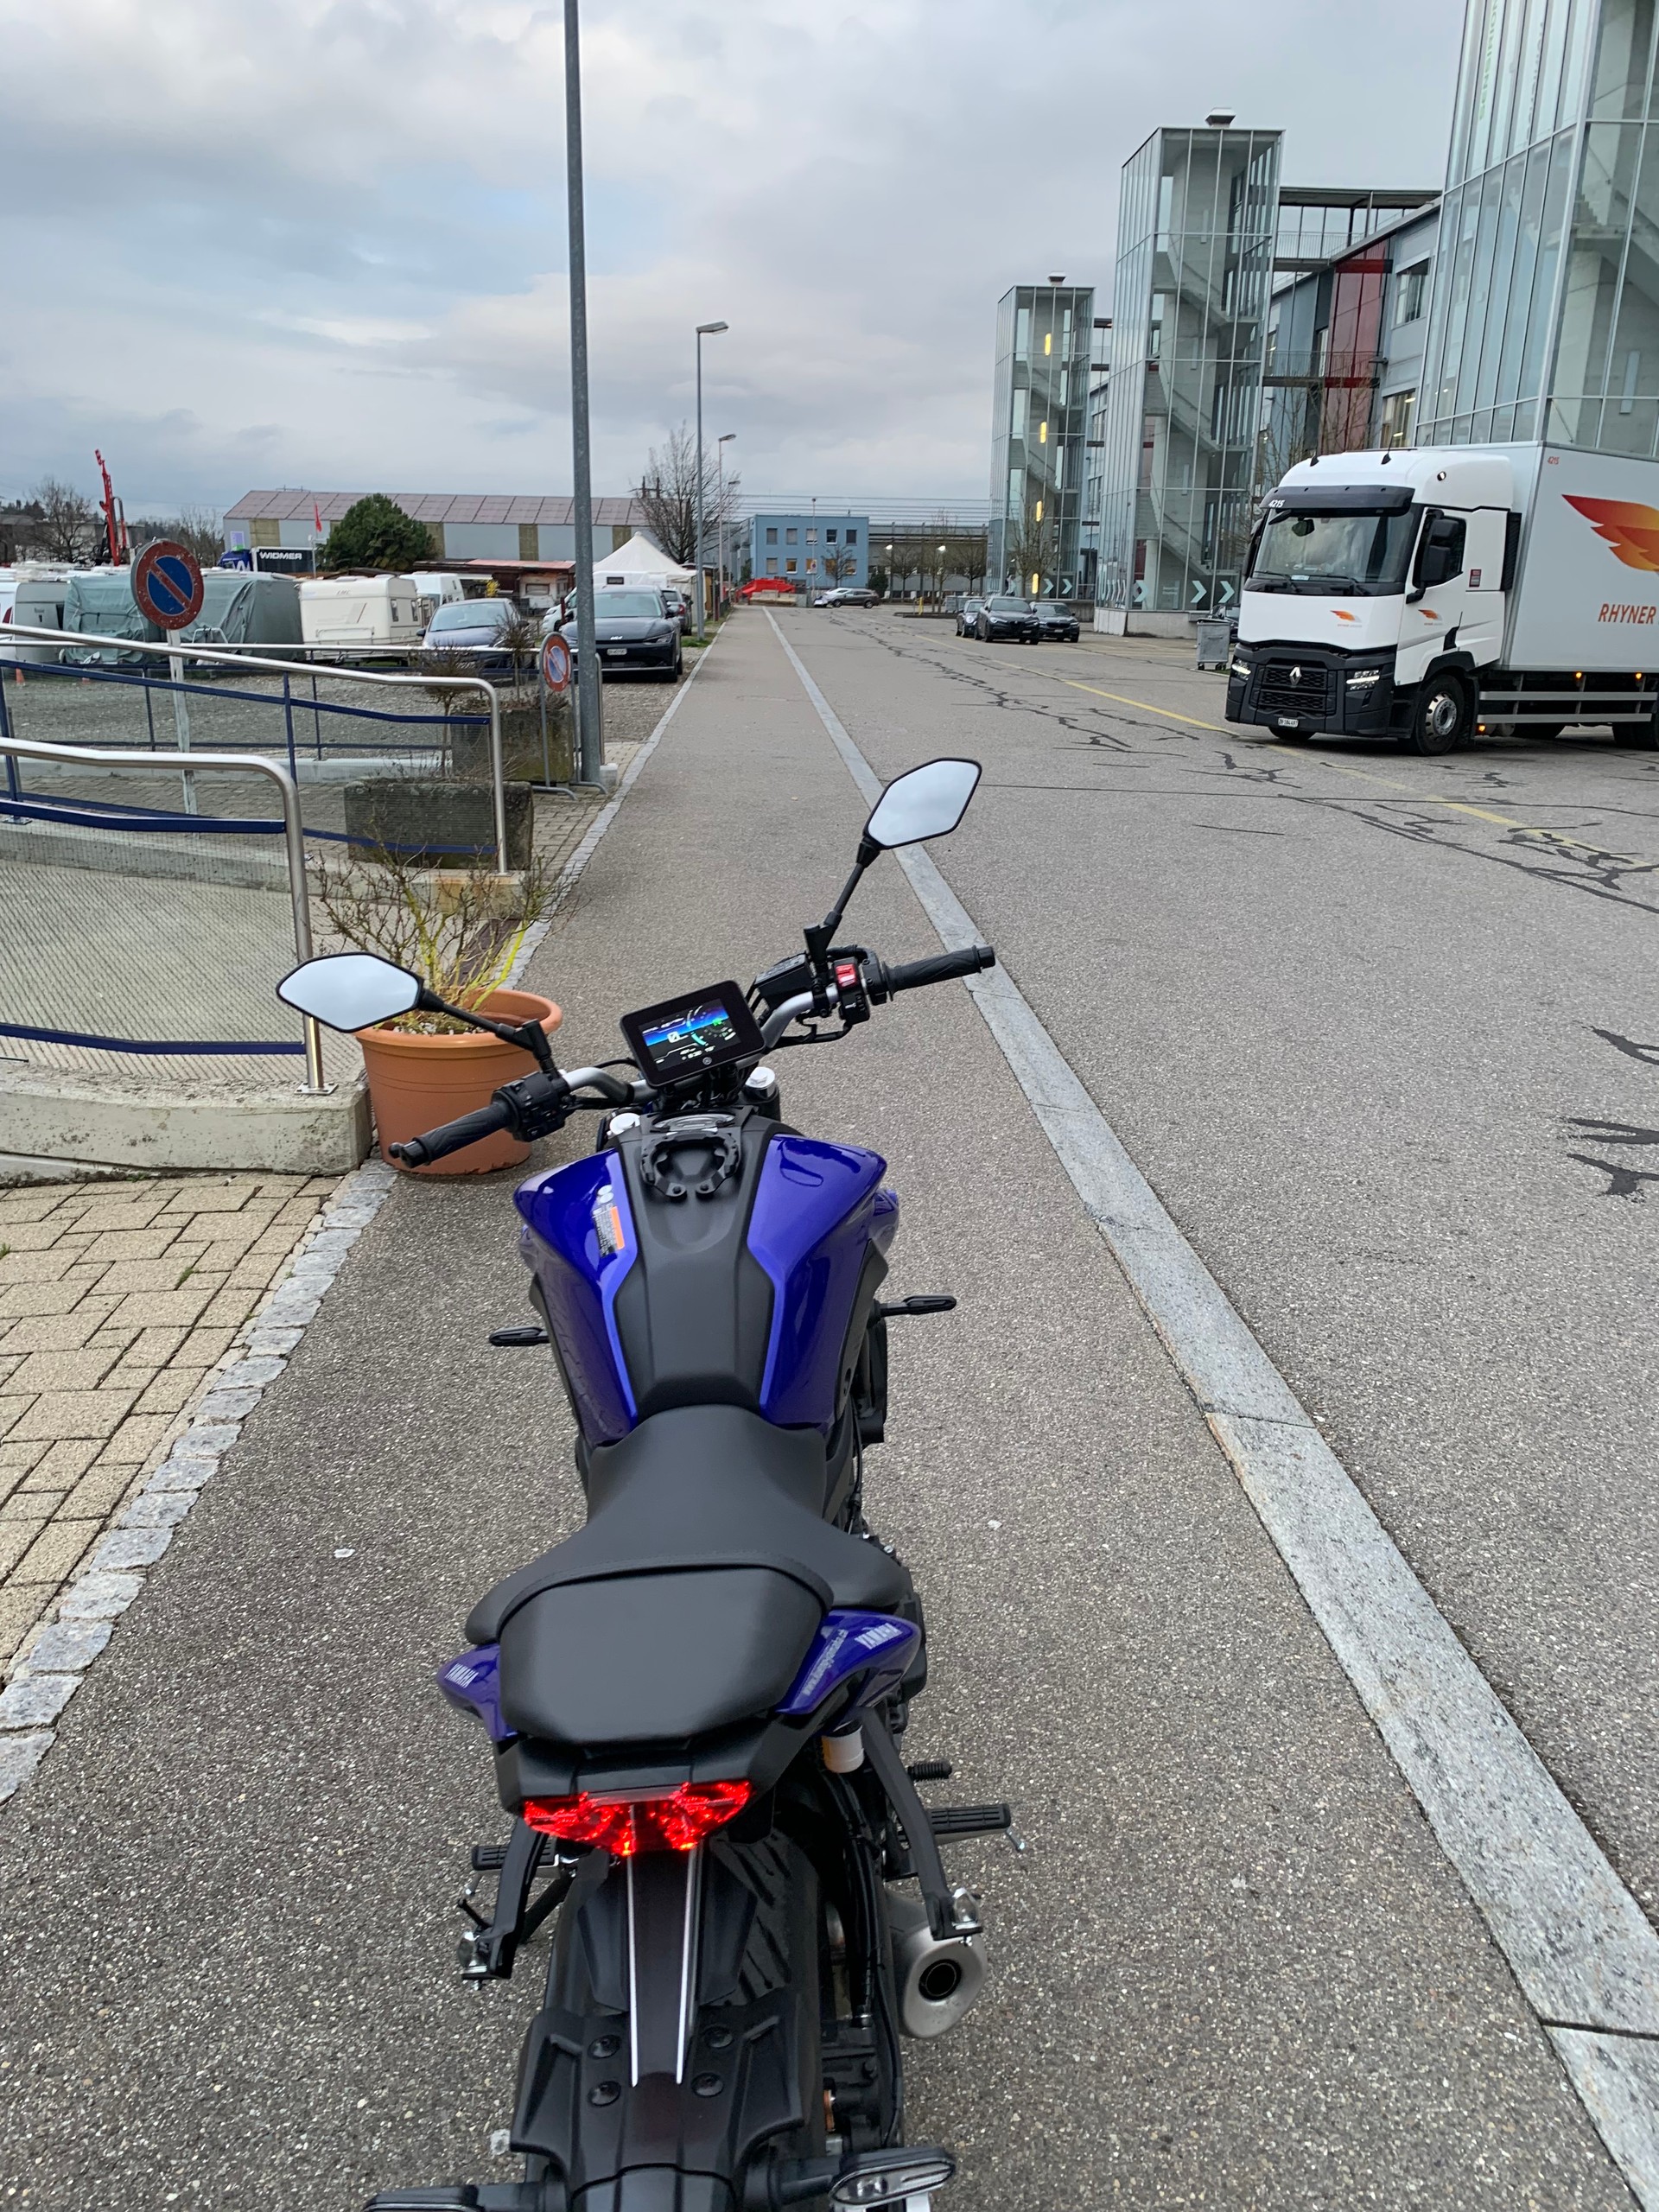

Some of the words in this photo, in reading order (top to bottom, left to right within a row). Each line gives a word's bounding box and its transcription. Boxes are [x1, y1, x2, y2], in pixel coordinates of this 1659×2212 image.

[1268, 499, 1286, 508] 4215
[1598, 603, 1656, 624] RHYNER
[853, 1623, 903, 1649] YAMAHA
[444, 1663, 480, 1689] YAMAHA
